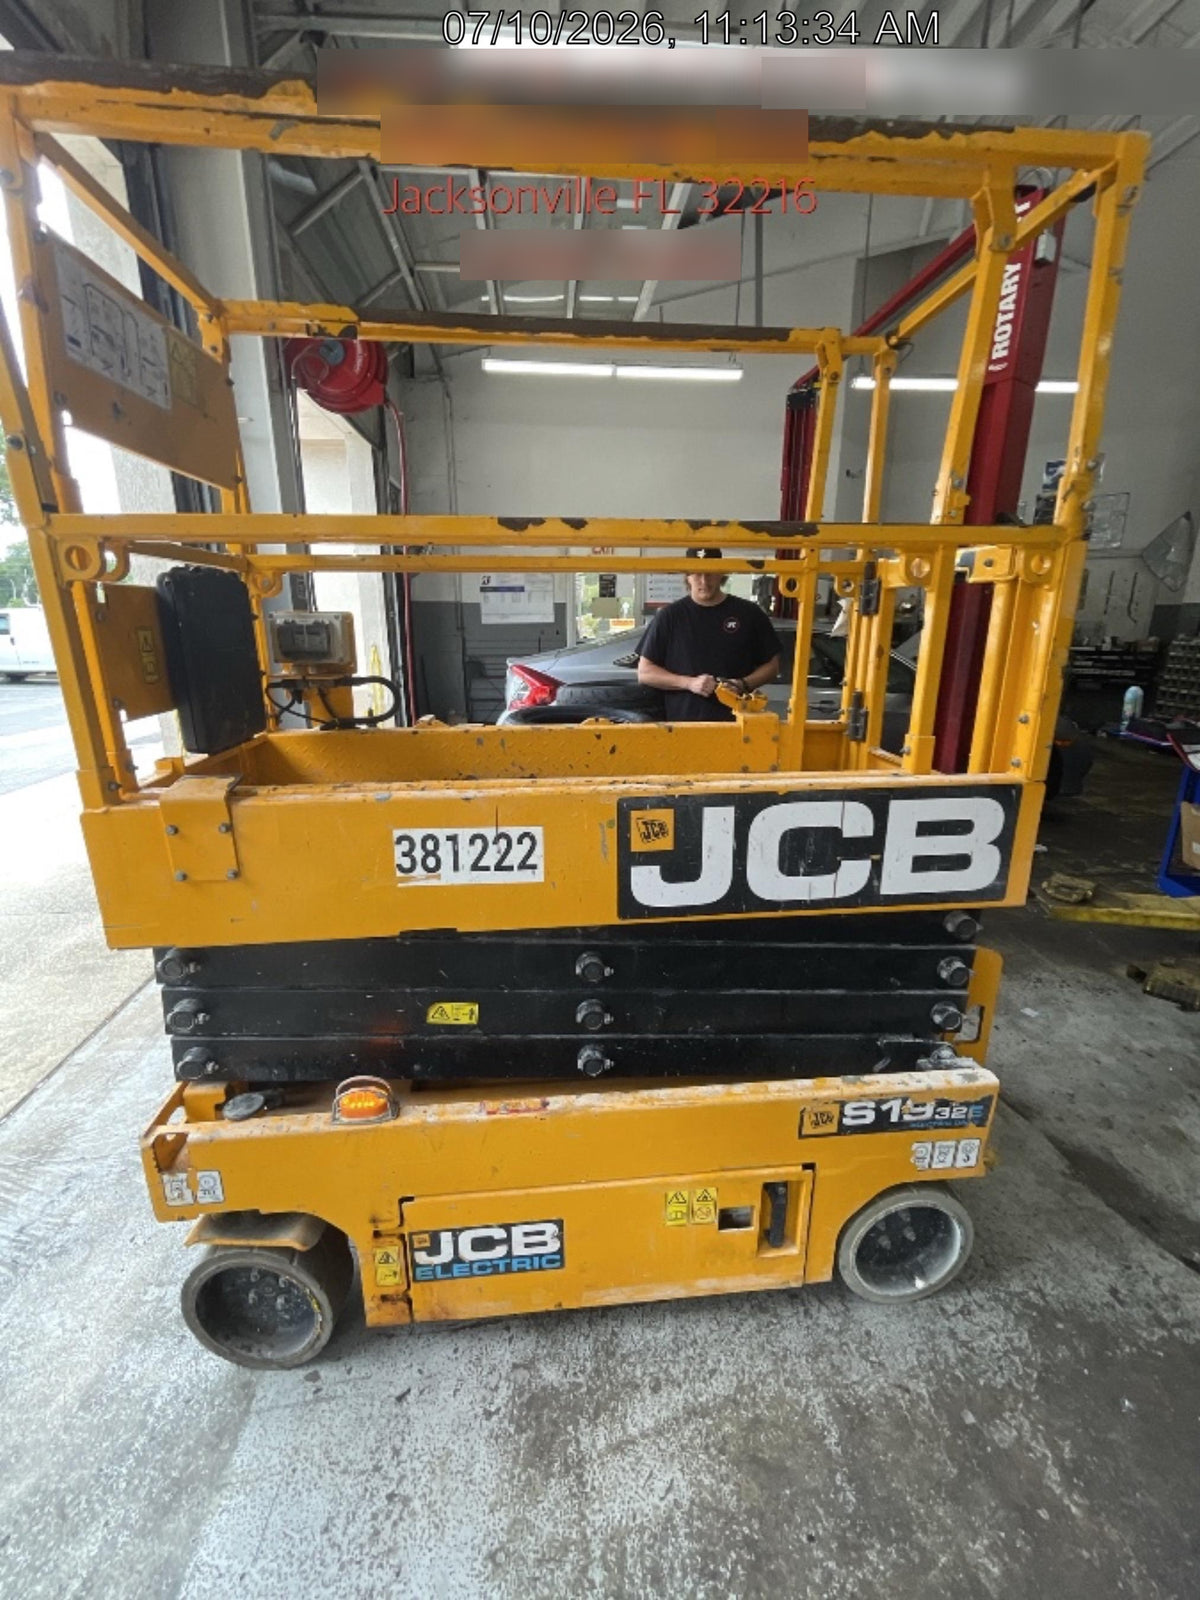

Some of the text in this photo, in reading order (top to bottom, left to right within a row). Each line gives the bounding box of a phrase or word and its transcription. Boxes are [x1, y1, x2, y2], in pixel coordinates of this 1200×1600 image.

[991, 263, 1022, 360] ROTARY
[394, 831, 538, 874] 381222
[630, 796, 1006, 908] JCB
[413, 1222, 561, 1265] JCB
[414, 1254, 561, 1281] ELECTRIC
